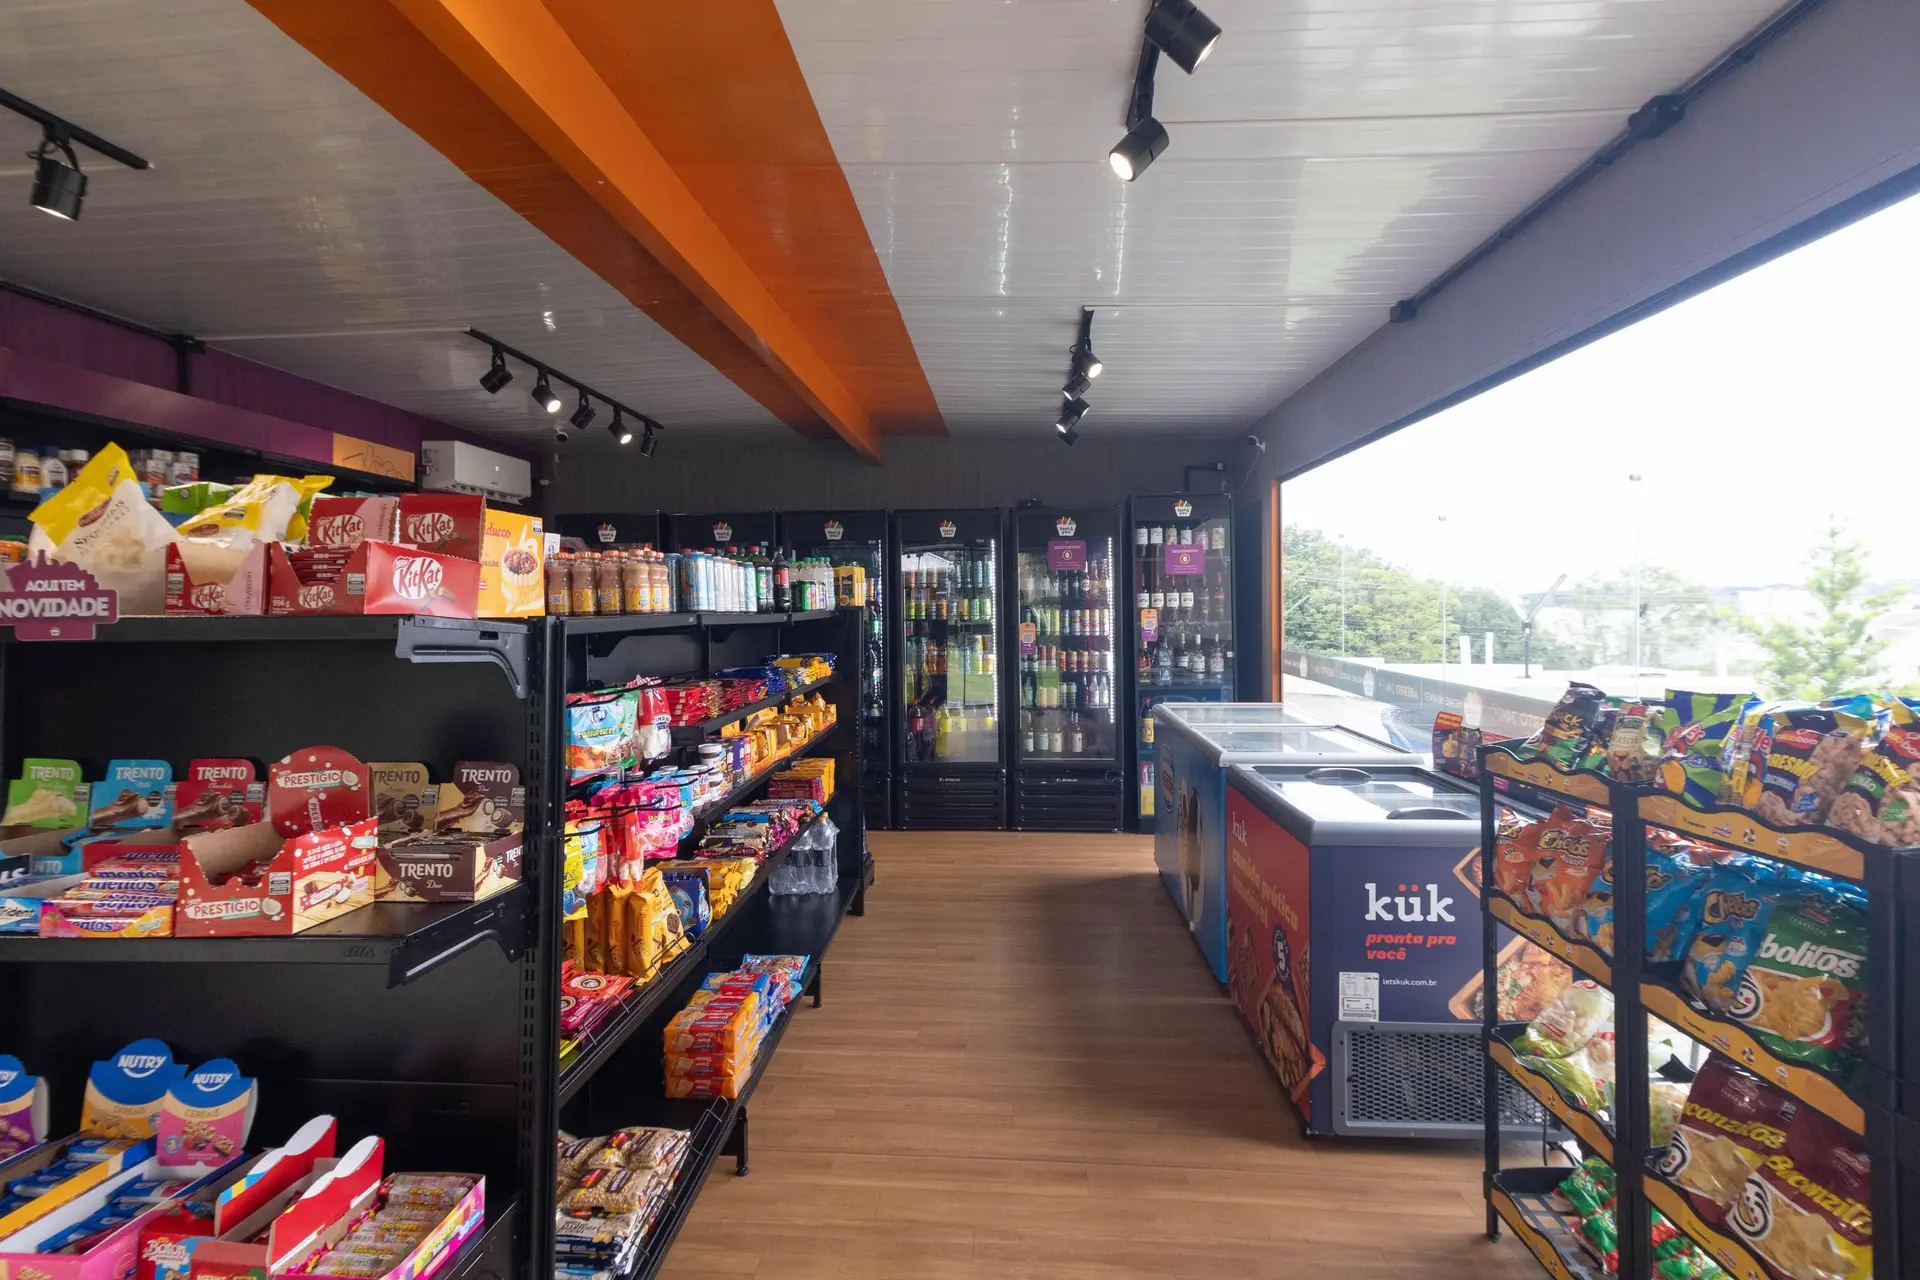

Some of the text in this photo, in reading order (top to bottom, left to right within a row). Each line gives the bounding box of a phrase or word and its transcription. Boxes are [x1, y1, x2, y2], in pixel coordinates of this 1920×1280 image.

[322, 514, 364, 545] KitKat
[413, 513, 452, 543] KitKat
[24, 580, 85, 592] AQUI TEM
[396, 558, 441, 598] KitKat
[193, 585, 227, 608] KitKat
[302, 586, 333, 608] KitKat
[0, 597, 109, 617] NOVIDADE
[30, 766, 74, 781] TRENTO
[116, 767, 164, 782] TRENTO
[197, 767, 247, 782] TRENTO
[374, 770, 420, 784] TRENTO
[461, 769, 512, 783] TRENTO
[1539, 829, 1590, 858] Cheetos
[399, 863, 453, 880] TRENTO
[1364, 882, 1456, 922] kük
[1704, 889, 1760, 926] Cheetos
[72, 921, 114, 932] entos
[1365, 932, 1457, 948] pronta pra
[1367, 947, 1407, 960] você
[1759, 933, 1866, 978] bolitos
[1382, 978, 1438, 987] letskuk.com.br
[118, 1055, 167, 1069] NUTRY
[192, 1072, 232, 1085] NUTRY
[1683, 1101, 1788, 1149] conzitos
